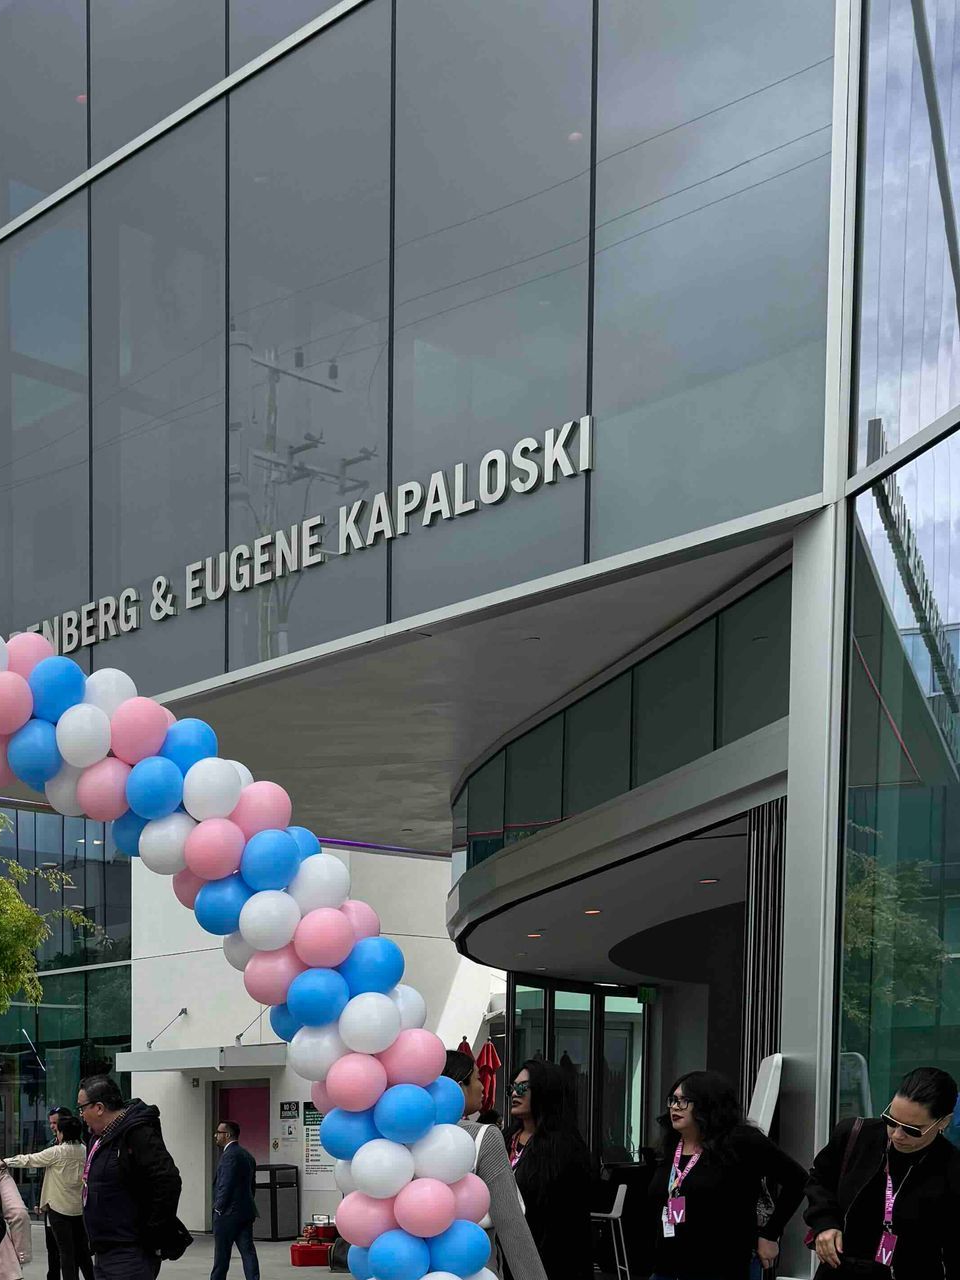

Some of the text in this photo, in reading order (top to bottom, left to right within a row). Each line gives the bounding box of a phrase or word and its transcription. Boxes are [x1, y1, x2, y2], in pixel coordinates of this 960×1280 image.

[9, 415, 592, 656] NBERG & EUGENE KAPALOSKI
